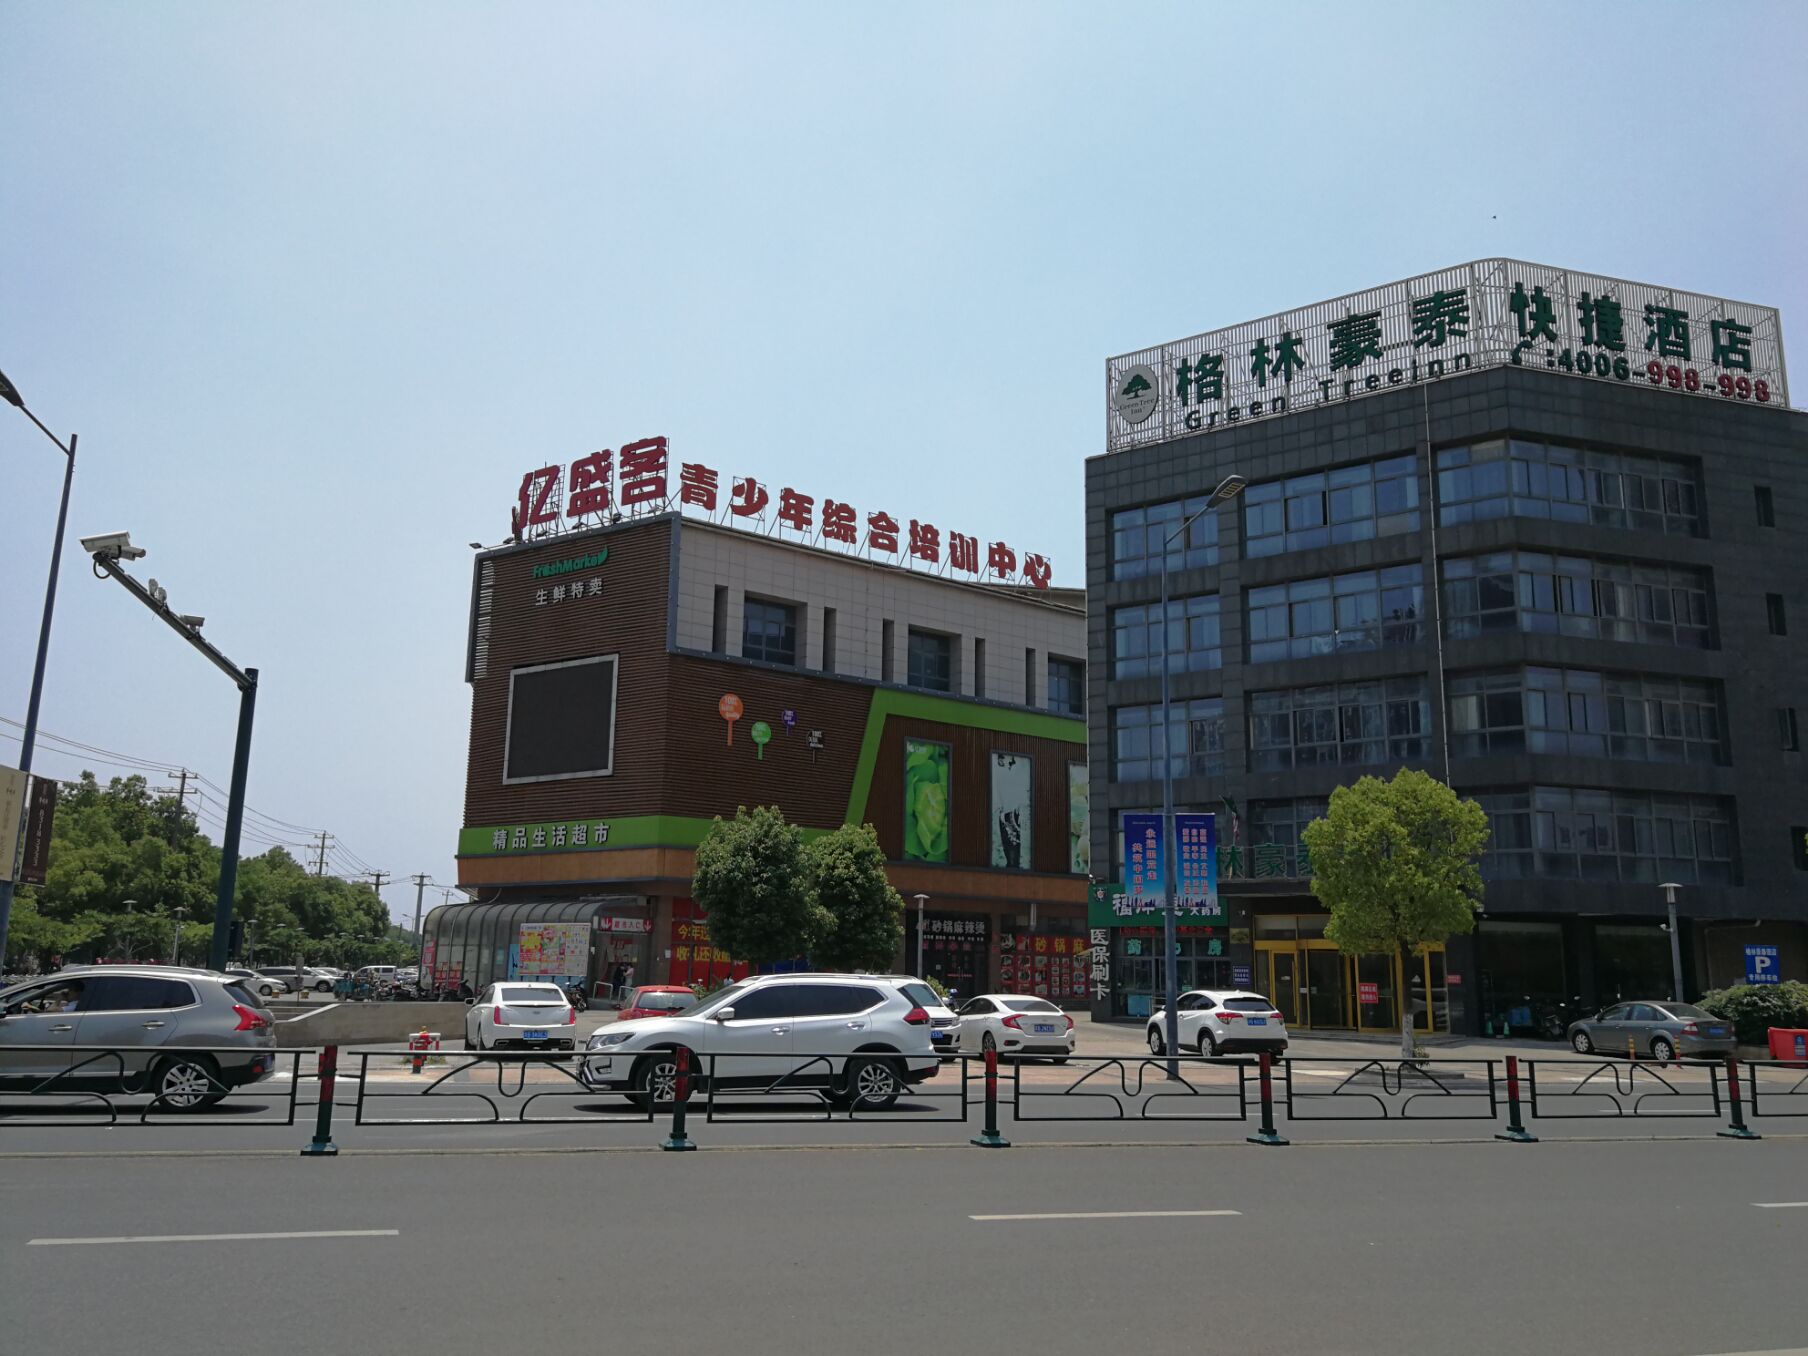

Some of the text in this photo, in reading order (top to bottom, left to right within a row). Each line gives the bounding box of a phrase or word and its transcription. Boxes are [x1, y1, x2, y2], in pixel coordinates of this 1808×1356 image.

[1176, 289, 1470, 406] 格林豪泰
[1510, 282, 1752, 373] 快捷酒店
[1185, 396, 1287, 430] Green
[517, 436, 668, 530] 亿盛客
[680, 462, 1052, 590] 青少年综合培训中心
[535, 576, 603, 606] 生鲜特卖
[492, 822, 611, 850] 精品生活超市
[1089, 929, 1110, 1000] 医保刷卡
[1754, 956, 1771, 973] P
